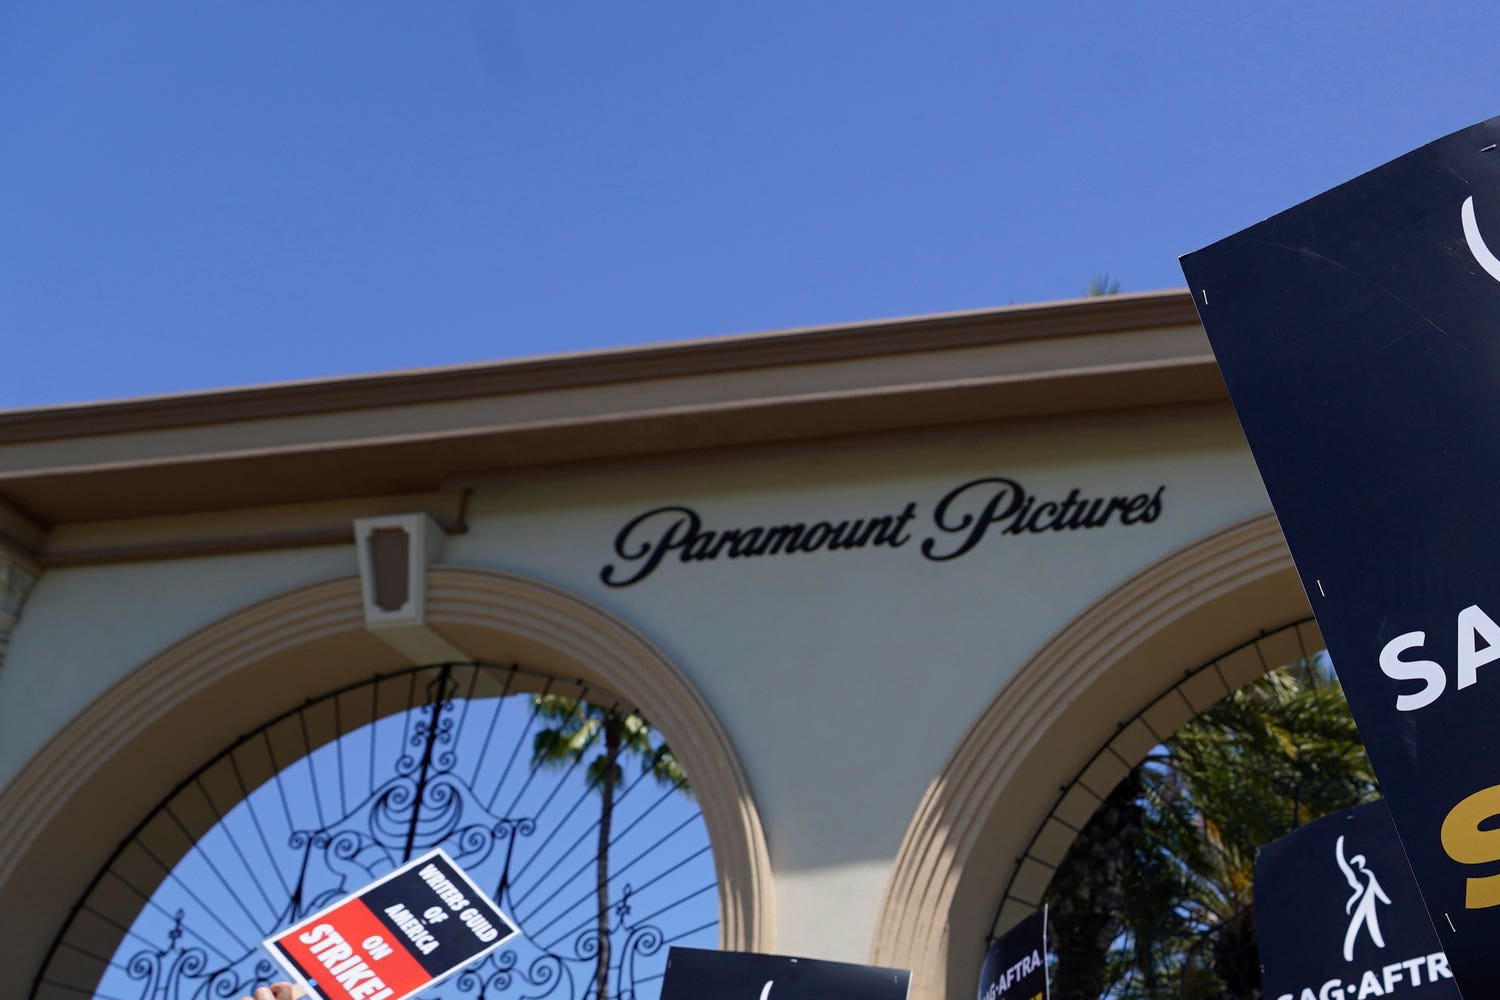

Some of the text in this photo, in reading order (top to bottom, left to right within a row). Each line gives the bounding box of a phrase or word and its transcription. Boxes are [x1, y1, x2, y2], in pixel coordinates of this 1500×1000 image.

[600, 477, 1166, 588] Paramount Pictures
[384, 903, 440, 956] AMERICA
[418, 863, 499, 943] WRITERS GUILD
[423, 906, 449, 924] OF
[361, 935, 394, 961] ON
